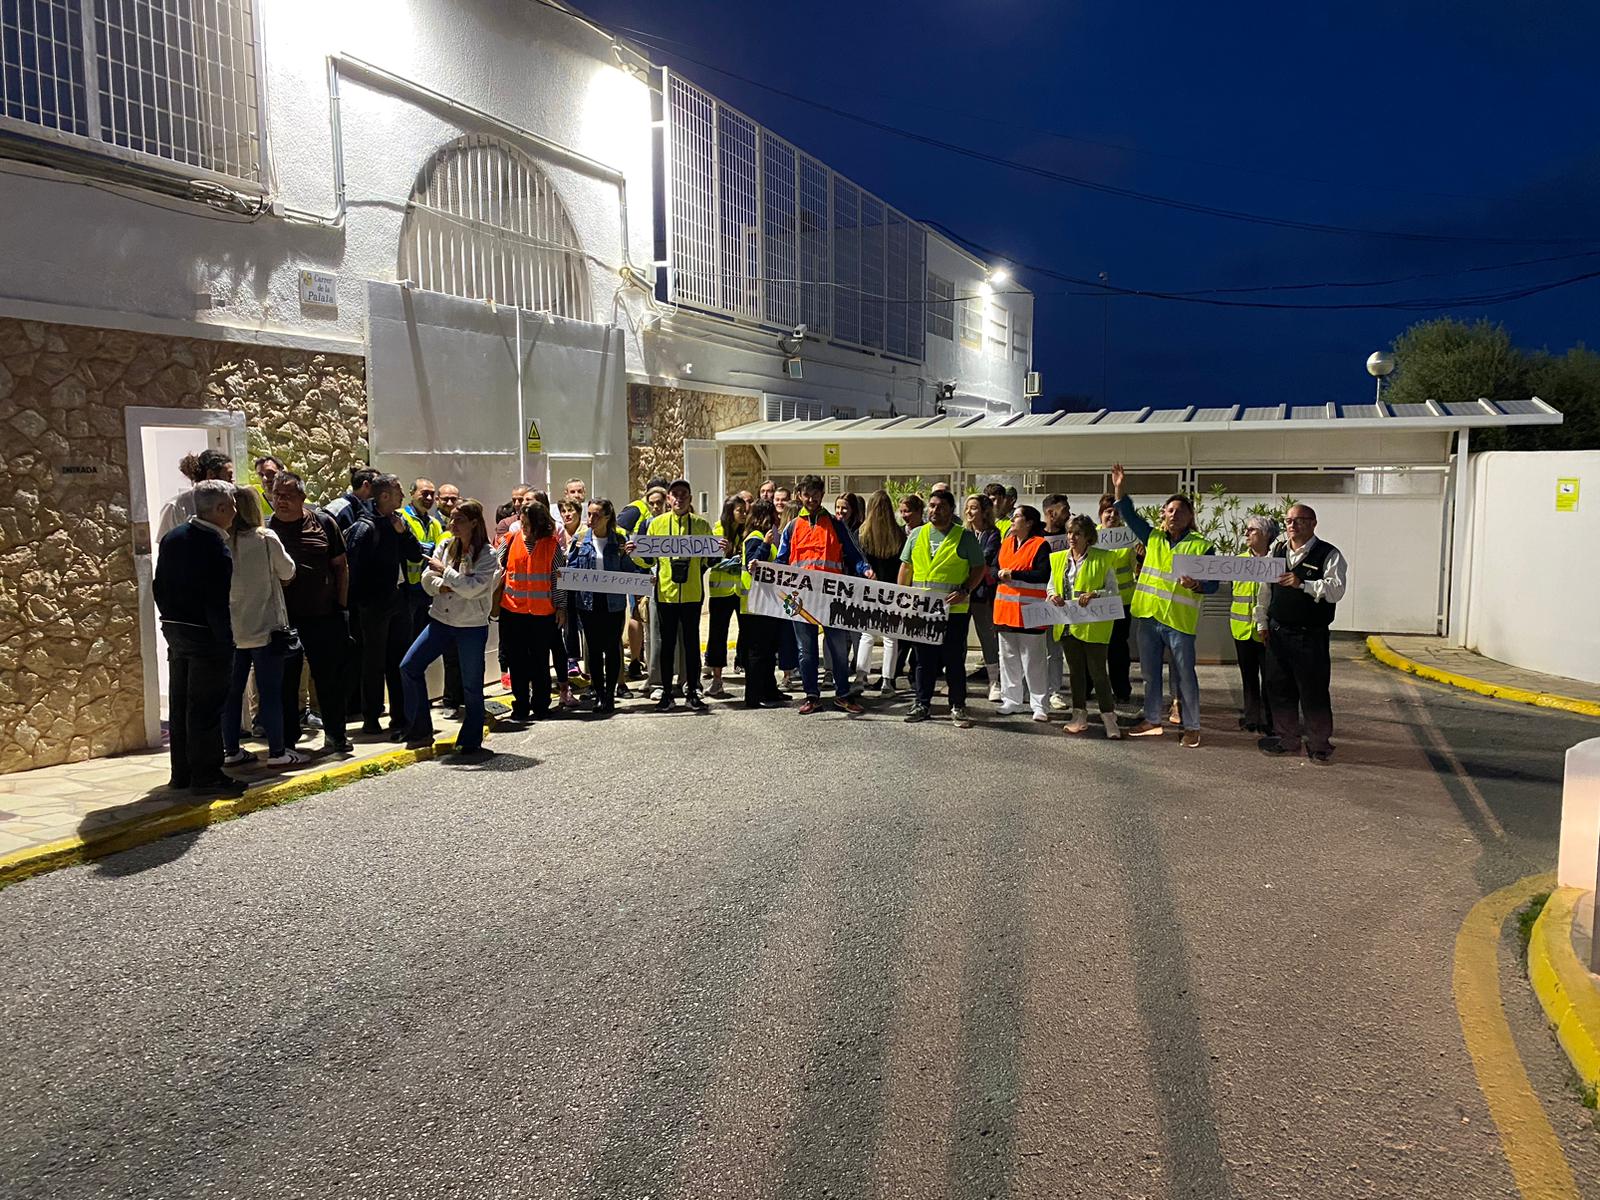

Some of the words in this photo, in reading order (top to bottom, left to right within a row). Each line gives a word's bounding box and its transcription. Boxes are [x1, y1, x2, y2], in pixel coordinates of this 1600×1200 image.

[317, 283, 324, 292] de
[560, 572, 650, 587] TRANSPORTE
[754, 566, 813, 592] IBIZA
[822, 578, 854, 599] EN
[863, 586, 946, 616] LUCHA
